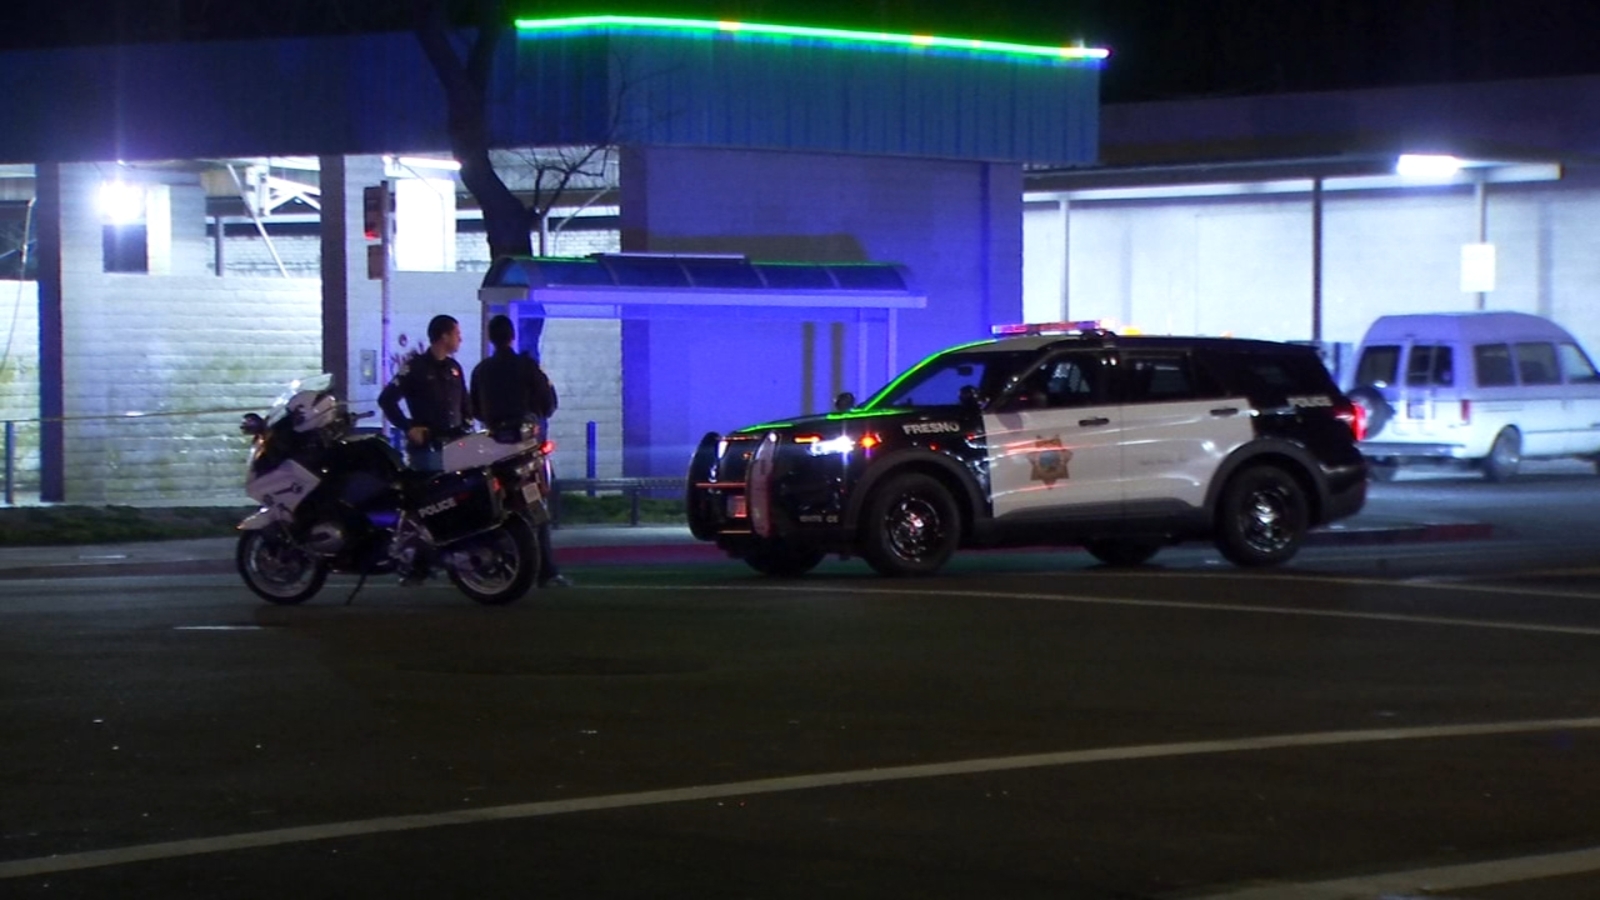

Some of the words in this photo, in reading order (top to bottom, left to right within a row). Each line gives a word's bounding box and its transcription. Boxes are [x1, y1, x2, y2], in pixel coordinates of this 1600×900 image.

[1287, 396, 1333, 407] POLICE
[903, 422, 960, 434] FRESNO
[418, 497, 457, 517] POLICE
